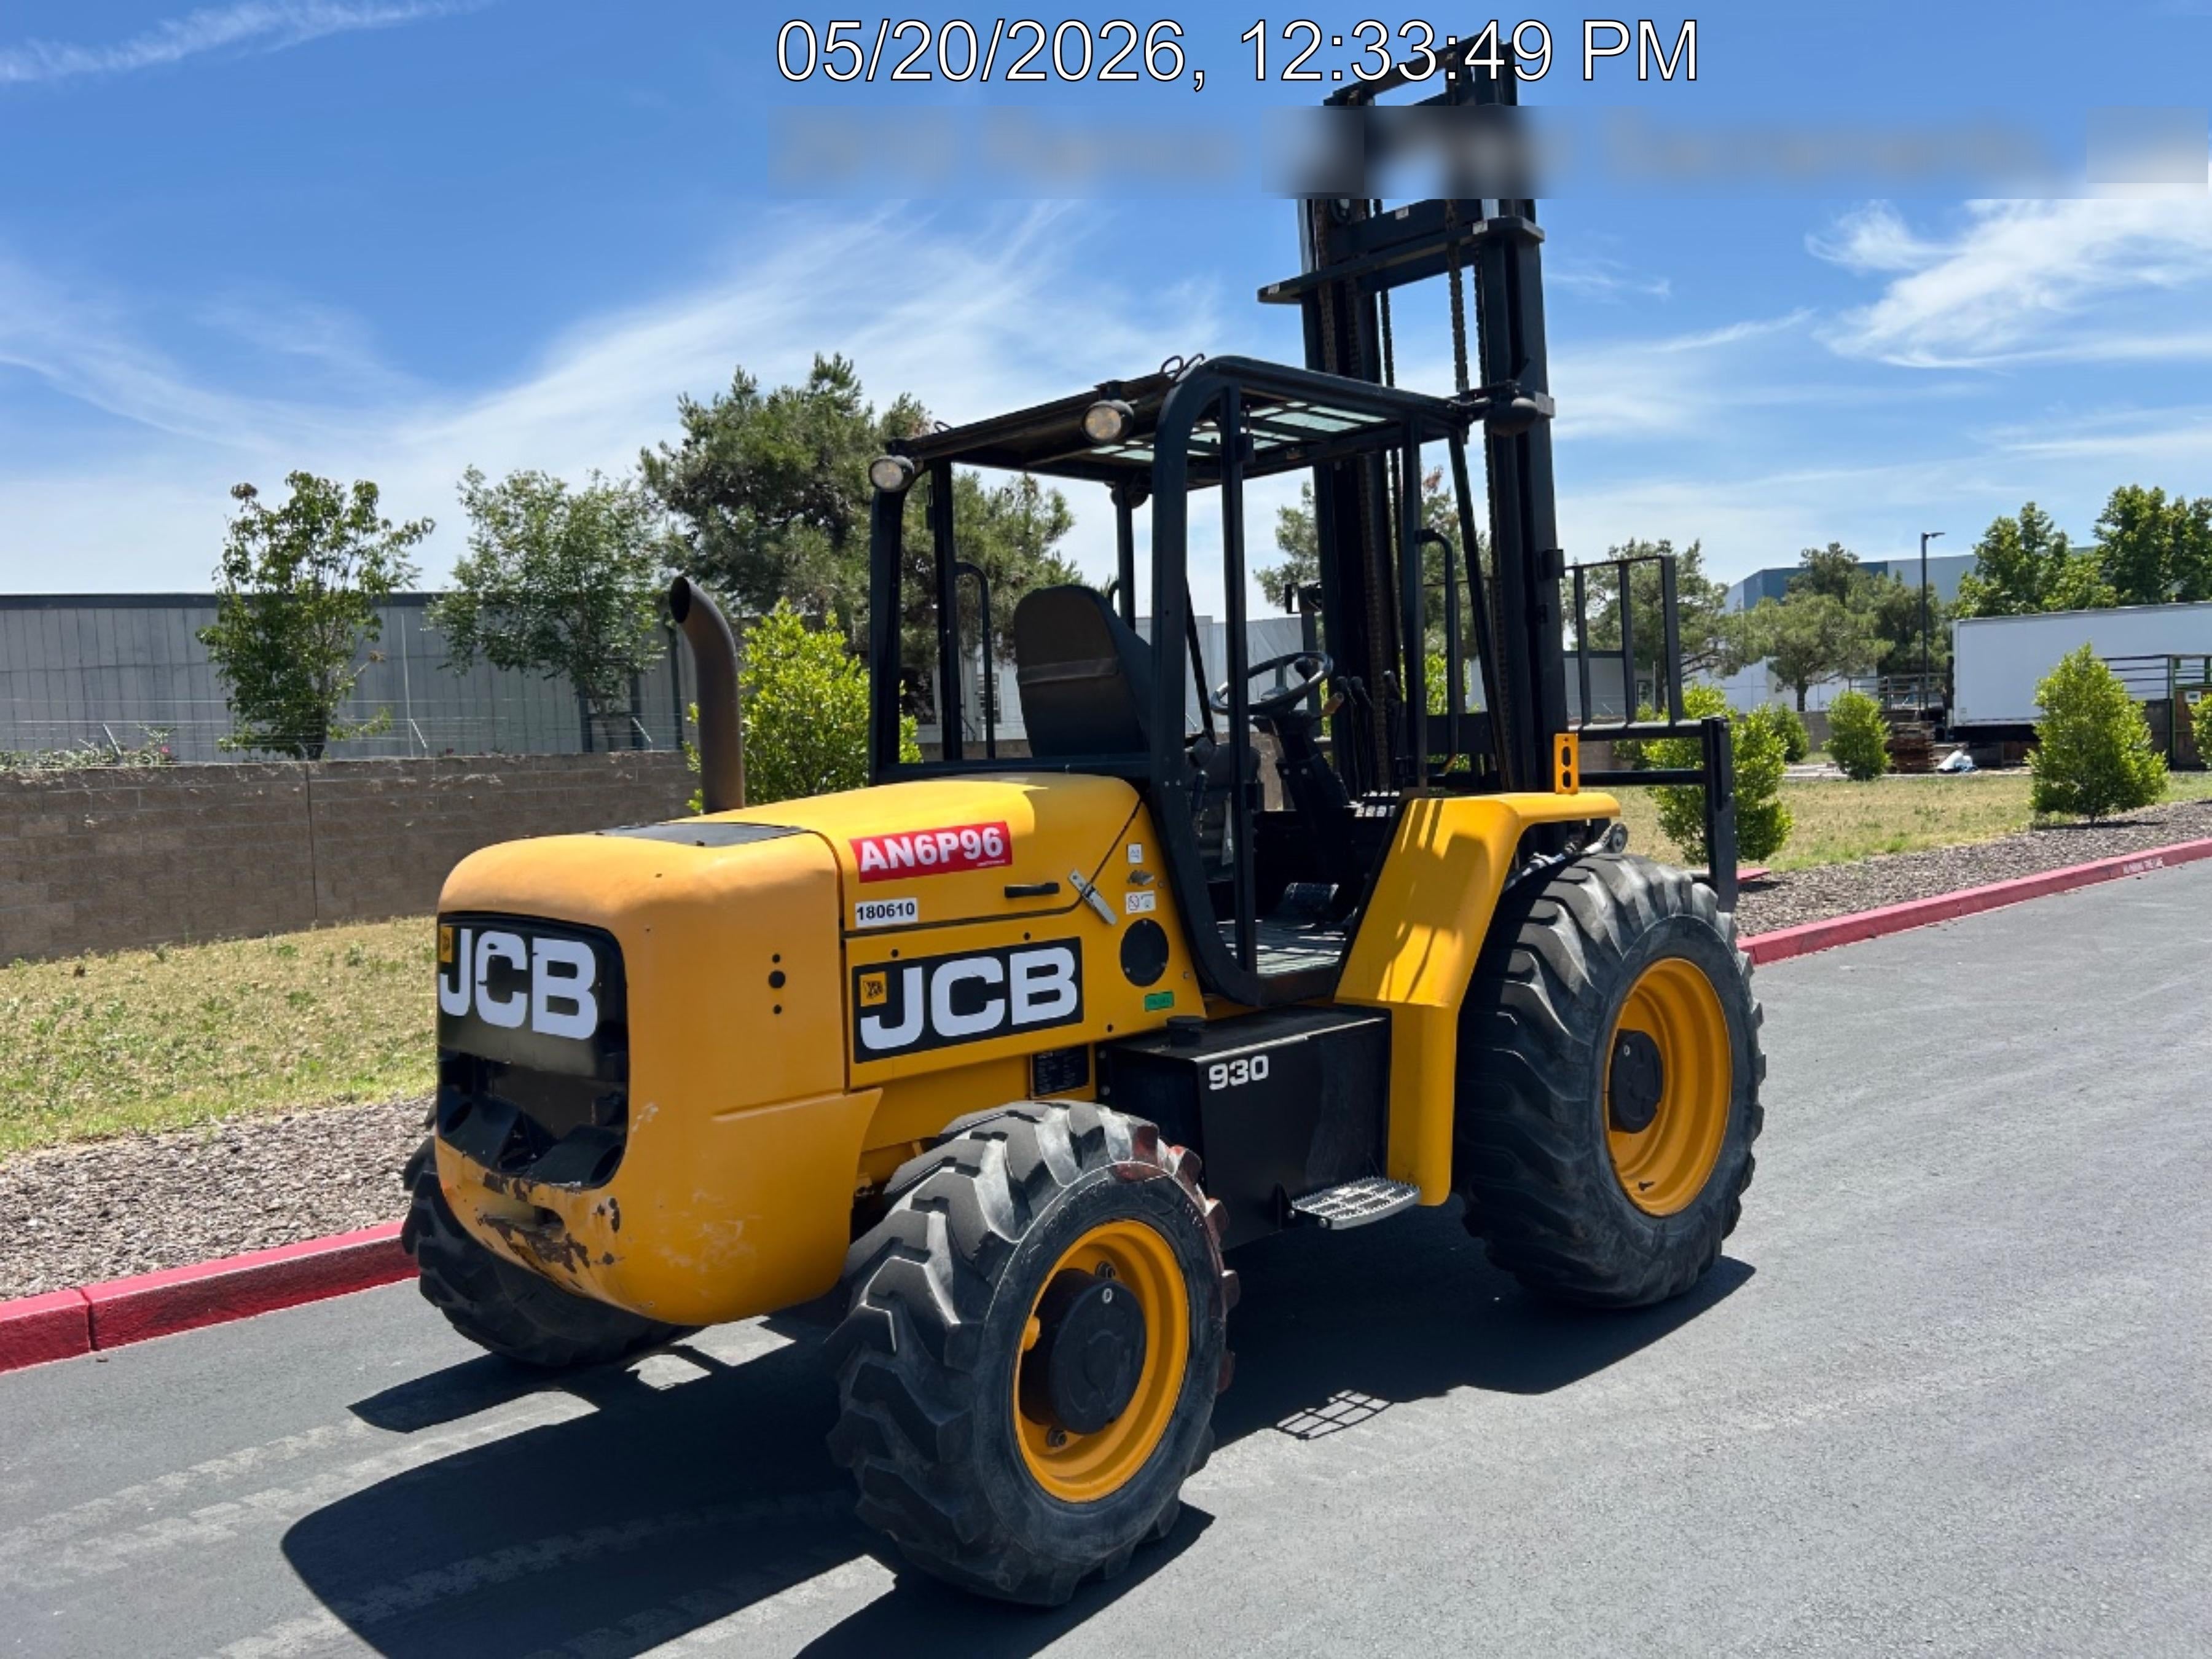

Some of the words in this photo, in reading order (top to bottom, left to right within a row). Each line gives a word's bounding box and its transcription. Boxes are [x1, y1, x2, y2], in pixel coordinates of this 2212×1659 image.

[860, 827, 1003, 872] AN6P96
[857, 902, 916, 920] 180610
[439, 928, 598, 1040] JCB
[860, 947, 1078, 1049] JCB
[1209, 1055, 1269, 1090] 930
